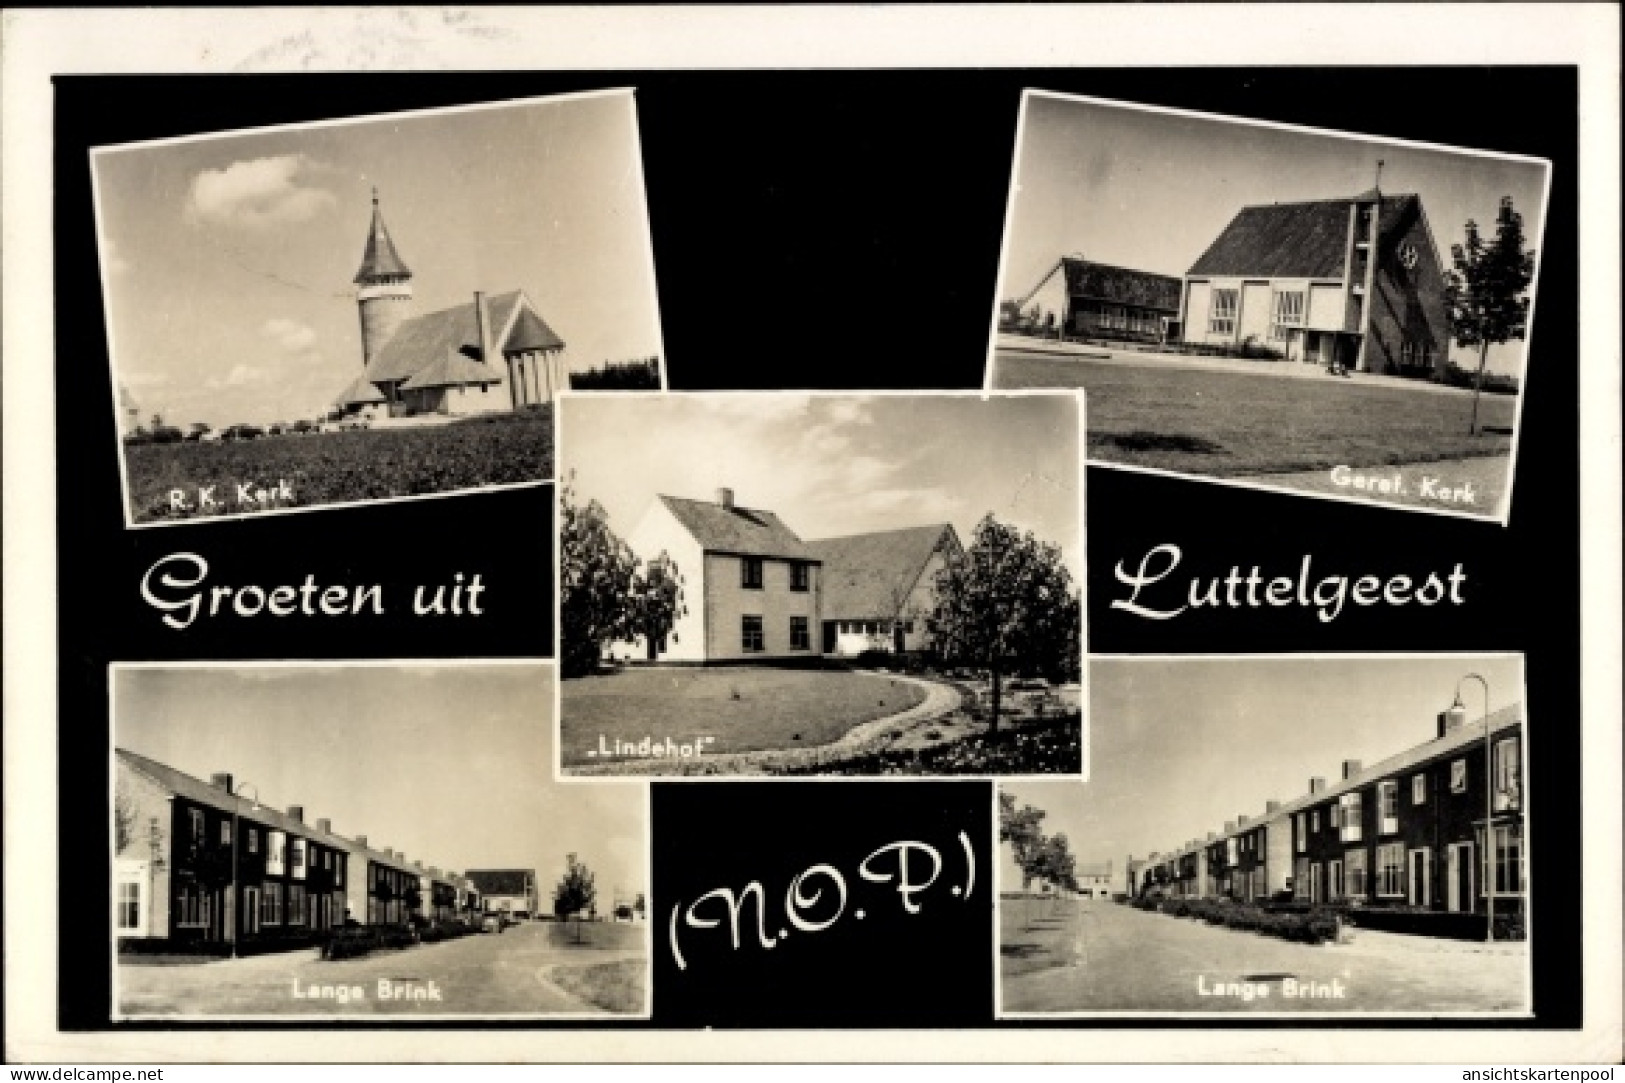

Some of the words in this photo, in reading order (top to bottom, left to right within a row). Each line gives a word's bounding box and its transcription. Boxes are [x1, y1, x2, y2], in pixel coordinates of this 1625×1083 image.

[237, 479, 294, 505] Kerk
[1420, 476, 1475, 505] Kerk
[140, 551, 385, 630] Groeten
[413, 571, 486, 616] uit
[1109, 543, 1468, 623] Luttelgeest
[293, 977, 366, 1004] Lange
[377, 977, 444, 1001] Brink
[1198, 975, 1270, 1002] Lange
[1282, 977, 1346, 999] Brink
